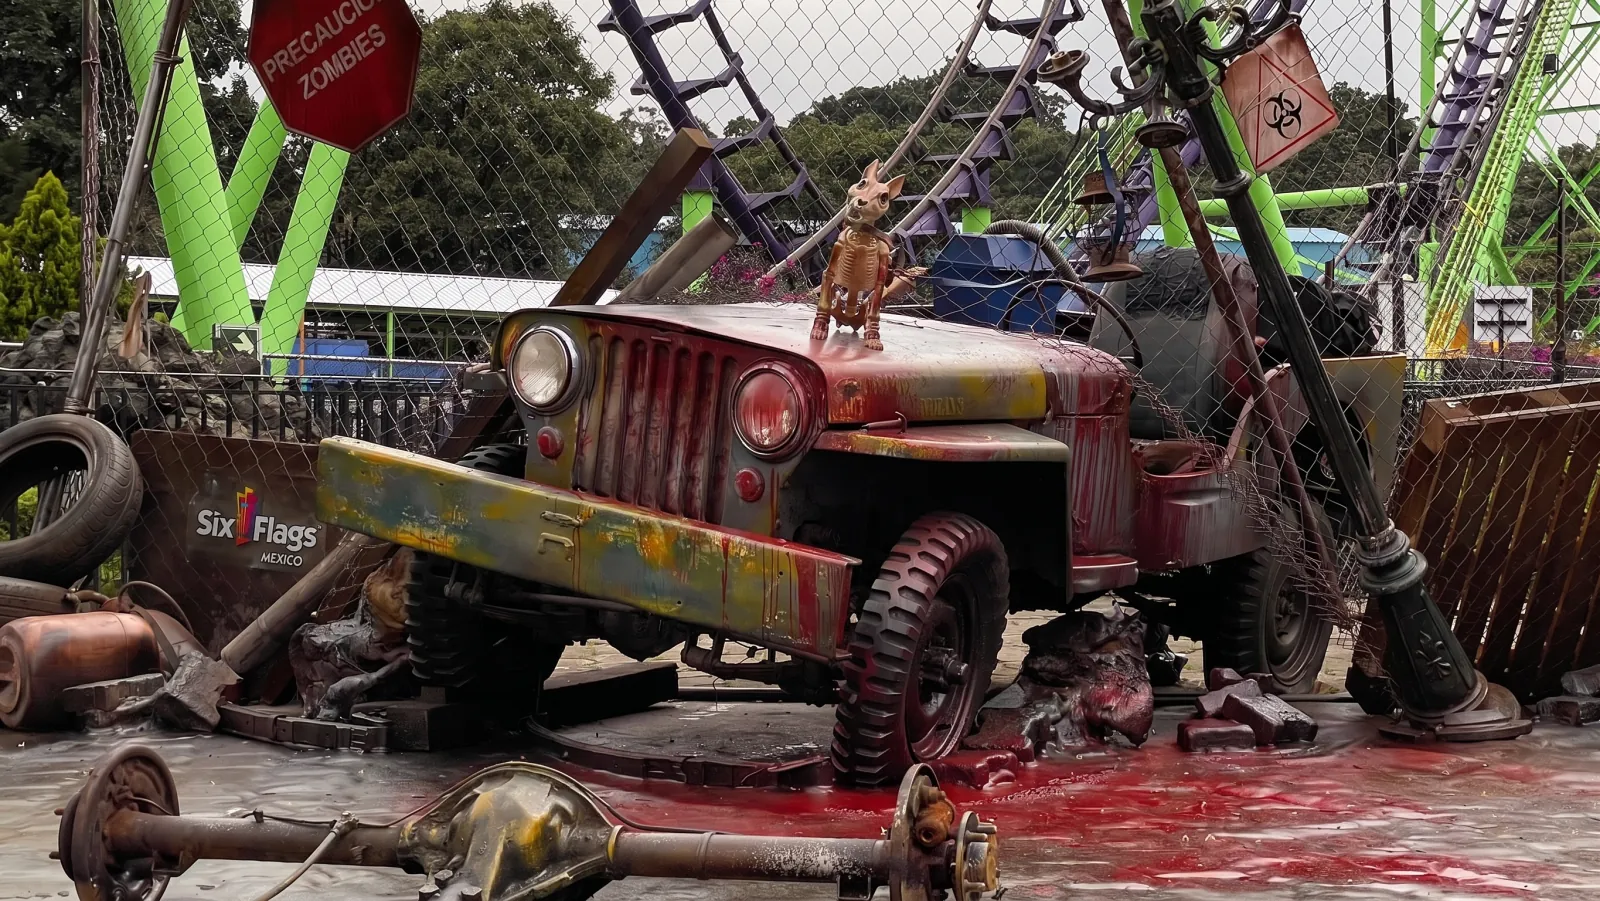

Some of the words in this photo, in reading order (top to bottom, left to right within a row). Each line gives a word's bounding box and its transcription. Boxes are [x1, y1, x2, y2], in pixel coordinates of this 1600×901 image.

[262, 0, 381, 83] PRECAUCI
[297, 23, 386, 100] ZOMBIES
[196, 509, 236, 539] Six
[252, 515, 317, 552] Flags
[260, 552, 303, 567] MEXICO
